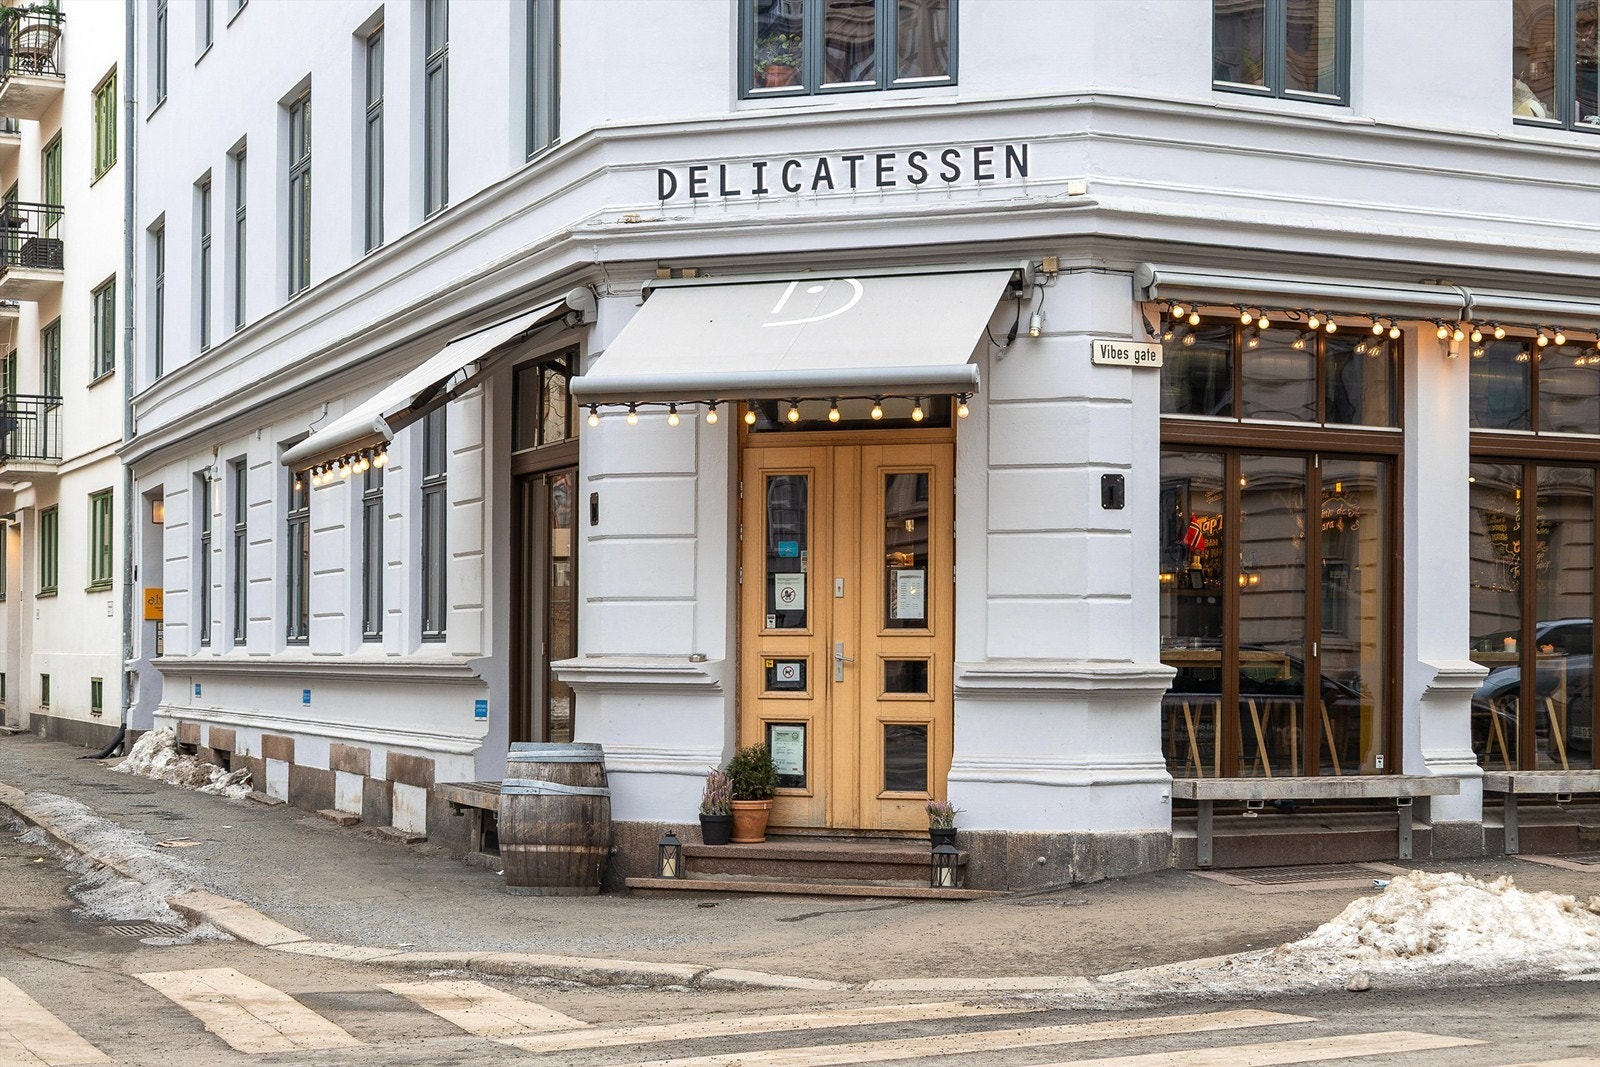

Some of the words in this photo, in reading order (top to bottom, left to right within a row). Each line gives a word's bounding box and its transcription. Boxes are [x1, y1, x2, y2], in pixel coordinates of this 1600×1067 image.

[657, 143, 1029, 201] DELICATESSEN
[1100, 344, 1129, 360] Vibes
[1134, 348, 1156, 364] gate
